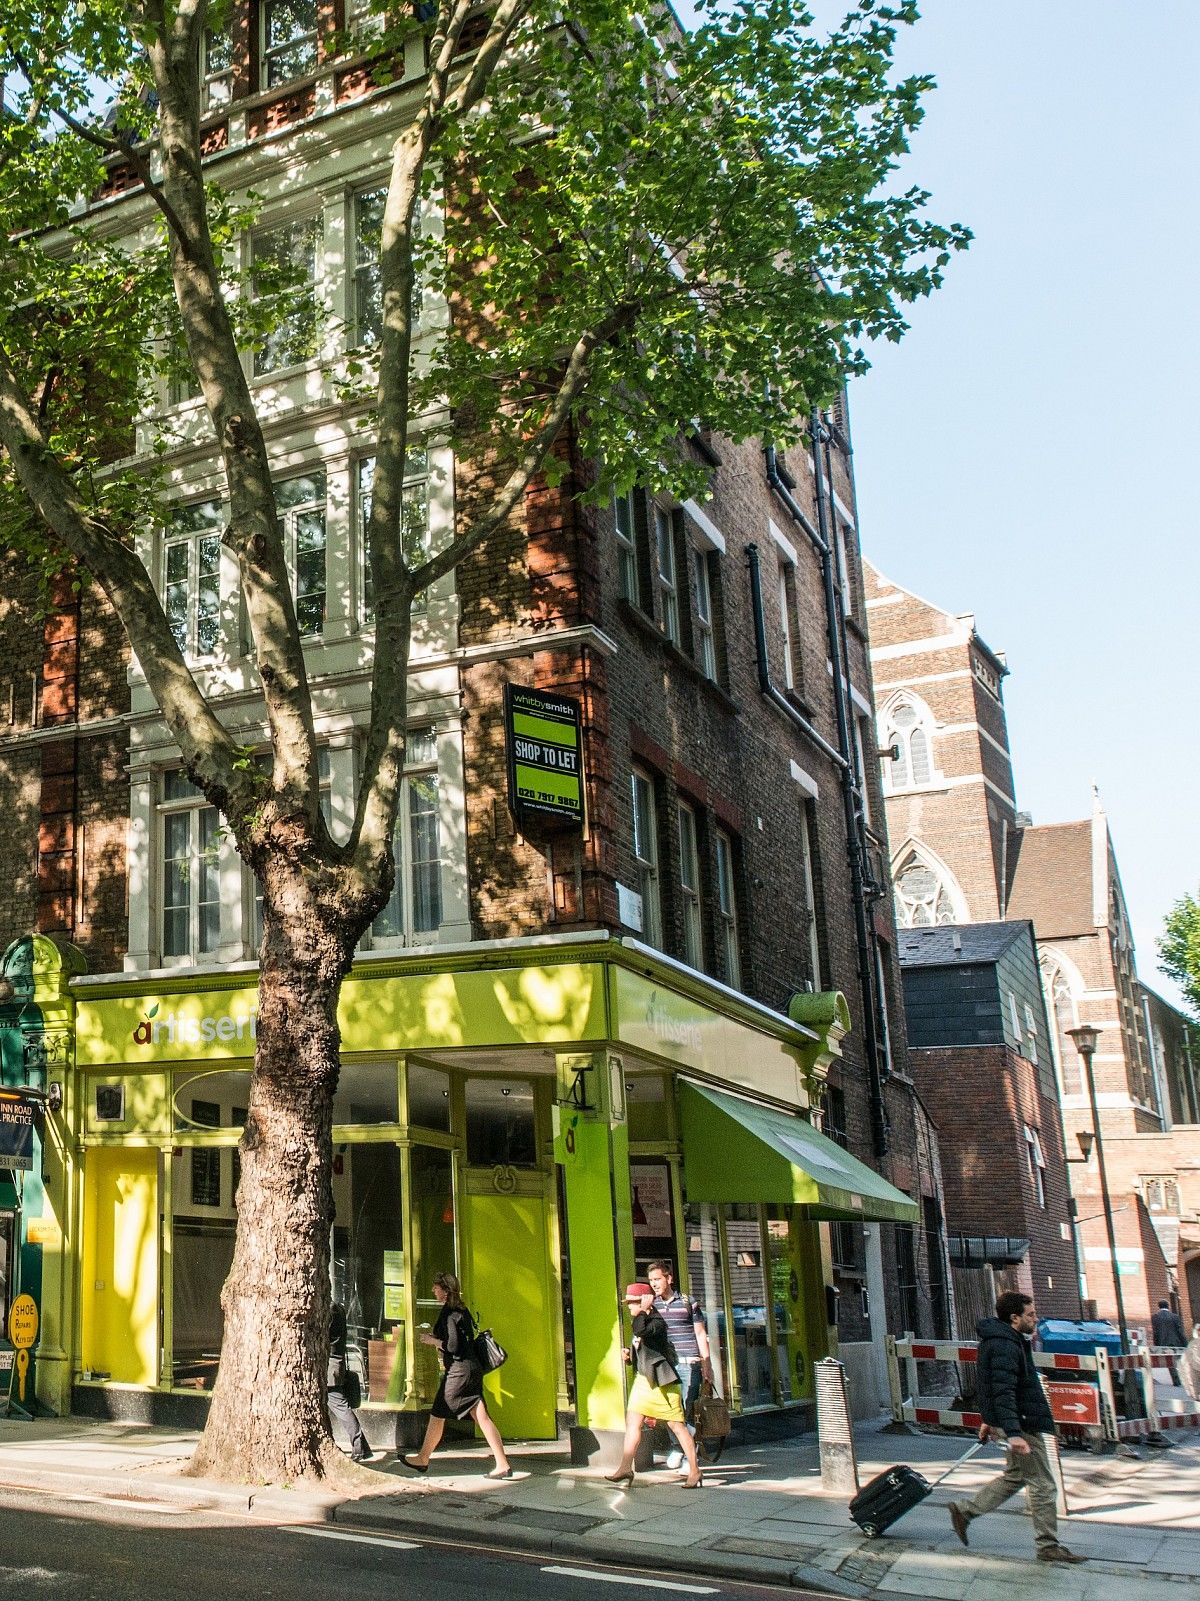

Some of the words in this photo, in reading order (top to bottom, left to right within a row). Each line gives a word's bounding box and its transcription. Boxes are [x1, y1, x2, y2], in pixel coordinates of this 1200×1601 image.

[513, 694, 574, 716] whitbysmith
[515, 740, 540, 761] SHOP
[542, 747, 556, 765] TO
[558, 751, 576, 769] LET
[518, 787, 536, 799] 020
[133, 1006, 257, 1045] artisseri
[0, 1103, 13, 1113] INN
[13, 1105, 32, 1116] ROAD
[2, 1113, 32, 1126] PRACTICE
[16, 1304, 35, 1316] SHOE
[1050, 1387, 1093, 1396] DESTRIANS
